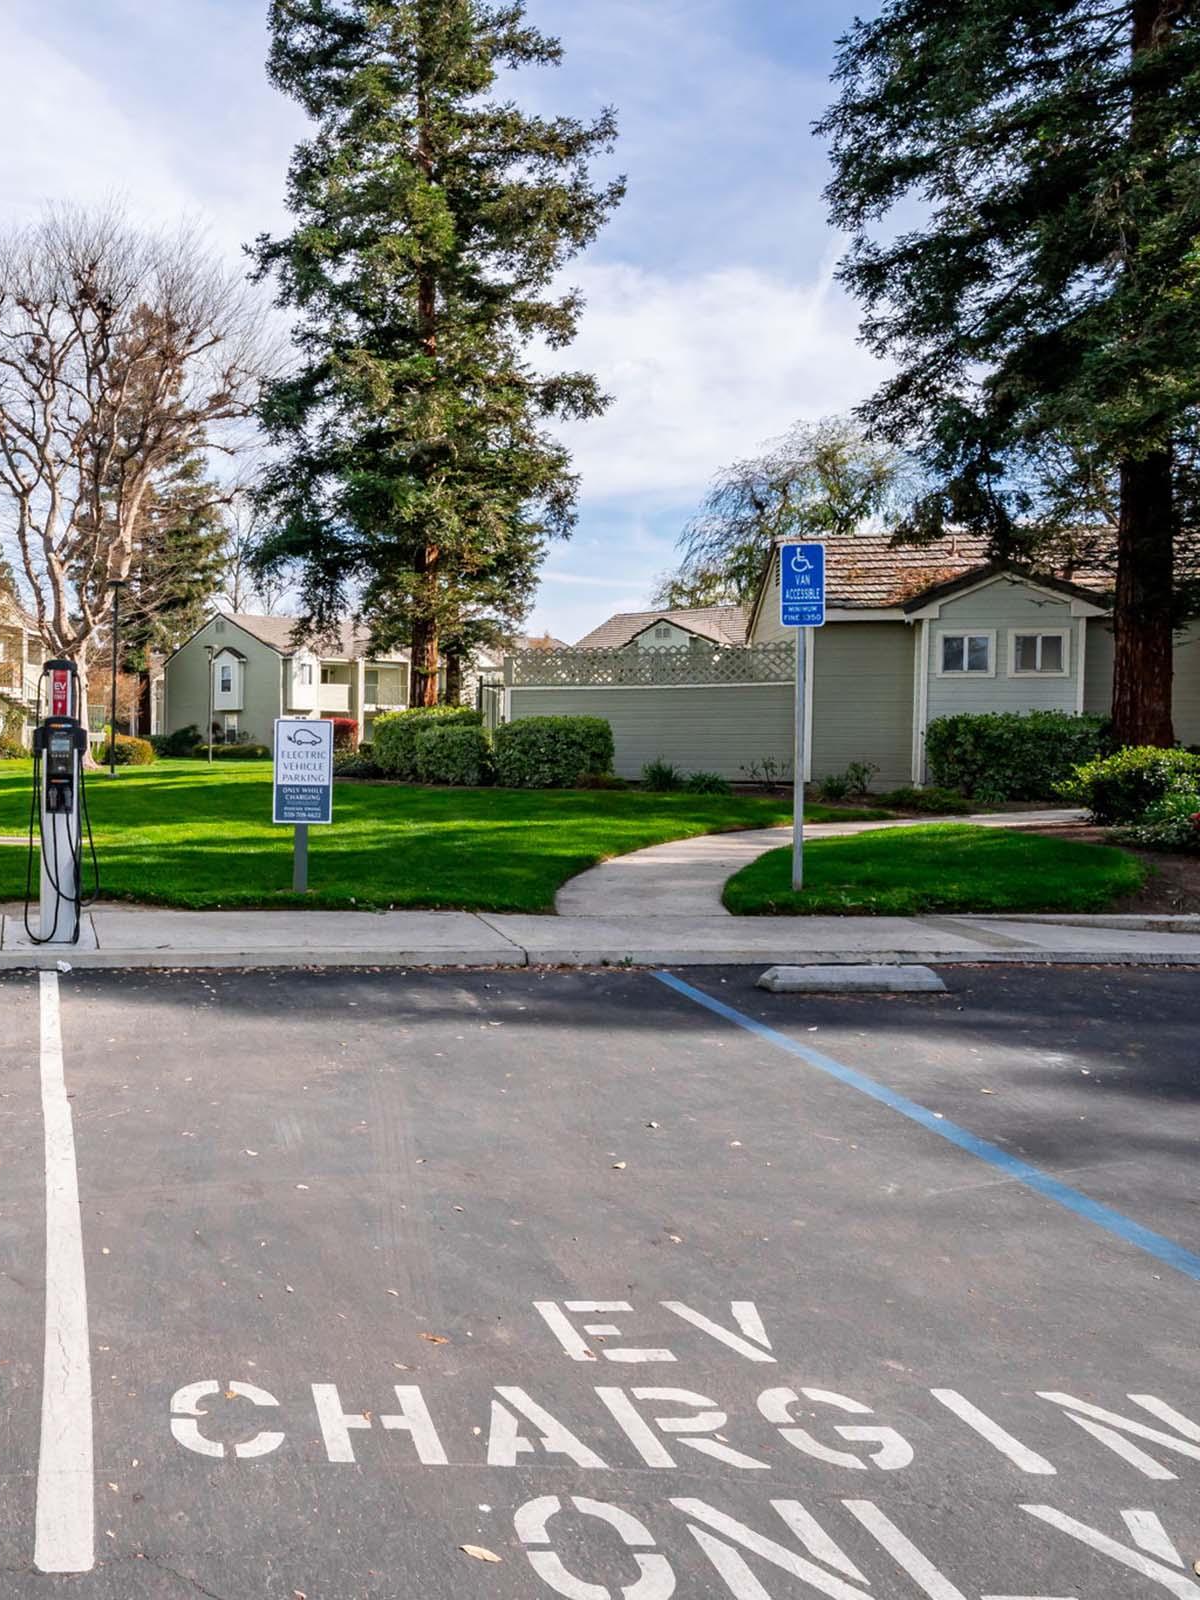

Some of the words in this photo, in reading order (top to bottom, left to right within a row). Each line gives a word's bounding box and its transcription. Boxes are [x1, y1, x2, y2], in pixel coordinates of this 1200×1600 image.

[794, 574, 811, 585] VAN
[785, 588, 820, 599] ACCESSIBLE
[54, 681, 67, 690] EV
[281, 751, 326, 759] ELECTRIC
[282, 762, 323, 771] VEHICLE
[282, 774, 325, 782] PARKING
[533, 1300, 778, 1363] EV
[169, 1379, 1200, 1480] CHARGIN
[513, 1495, 1200, 1600] ONLY
